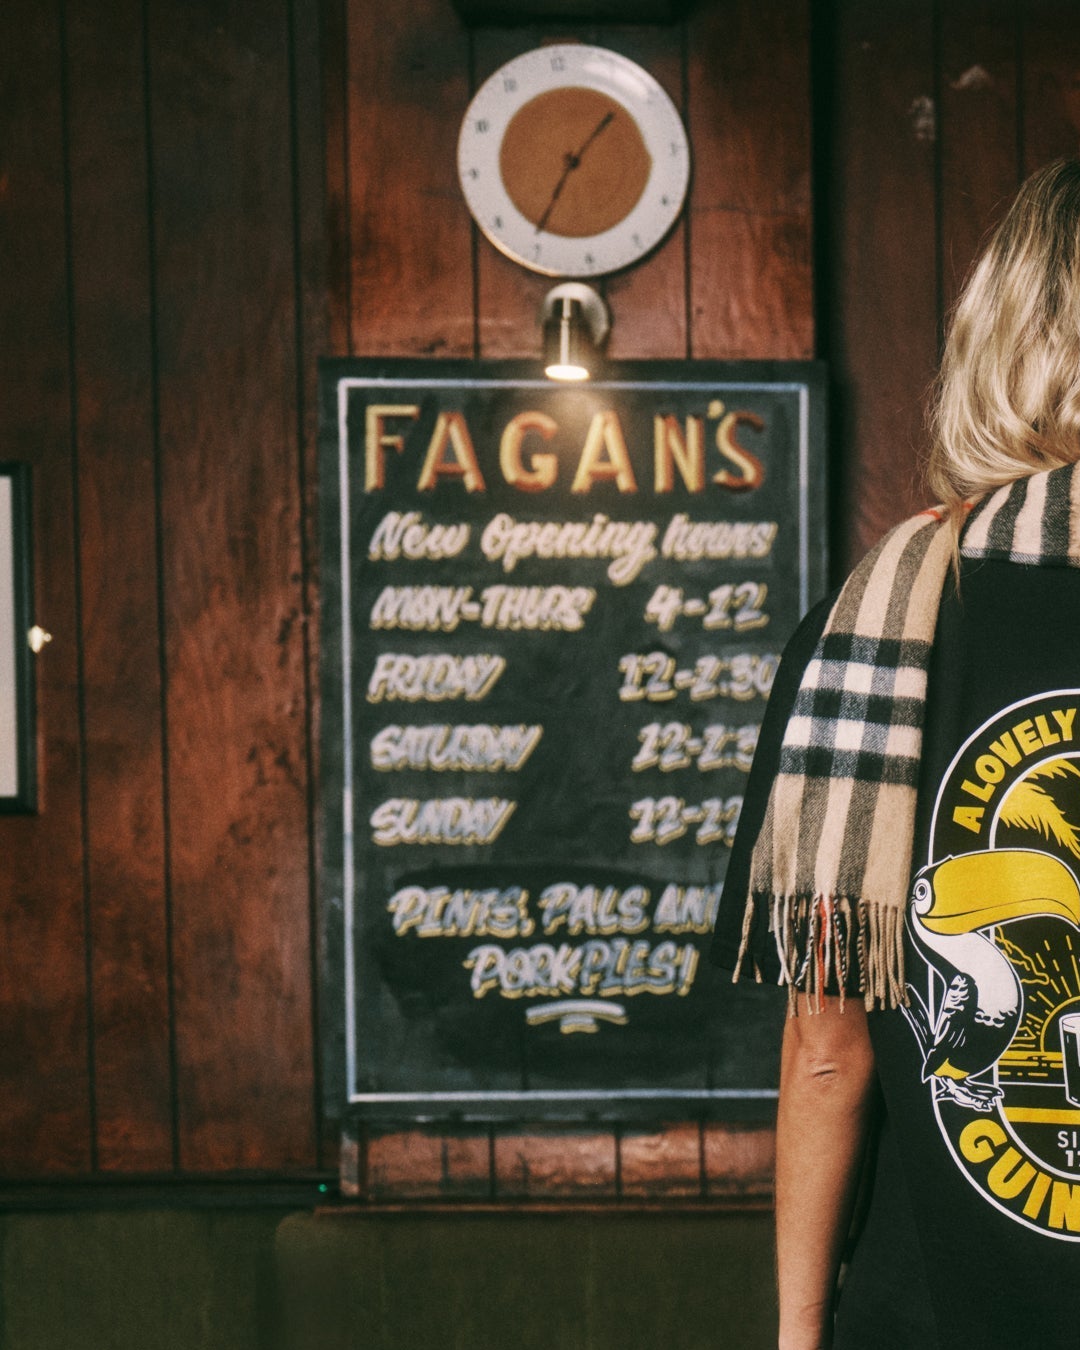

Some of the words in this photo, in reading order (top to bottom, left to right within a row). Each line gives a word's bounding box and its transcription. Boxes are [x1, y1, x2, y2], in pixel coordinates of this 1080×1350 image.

[364, 400, 765, 493] FAGAN'S
[369, 511, 470, 561] New
[480, 512, 657, 586] Opening
[369, 584, 597, 632] MON-THURS
[644, 582, 769, 632] 4-12
[366, 652, 506, 704] FRIDAY
[370, 723, 544, 772] SATURDAY
[960, 708, 1077, 802] LOVELY
[370, 797, 517, 847] SUNDAY
[952, 806, 985, 834] A
[538, 882, 650, 935] PALS
